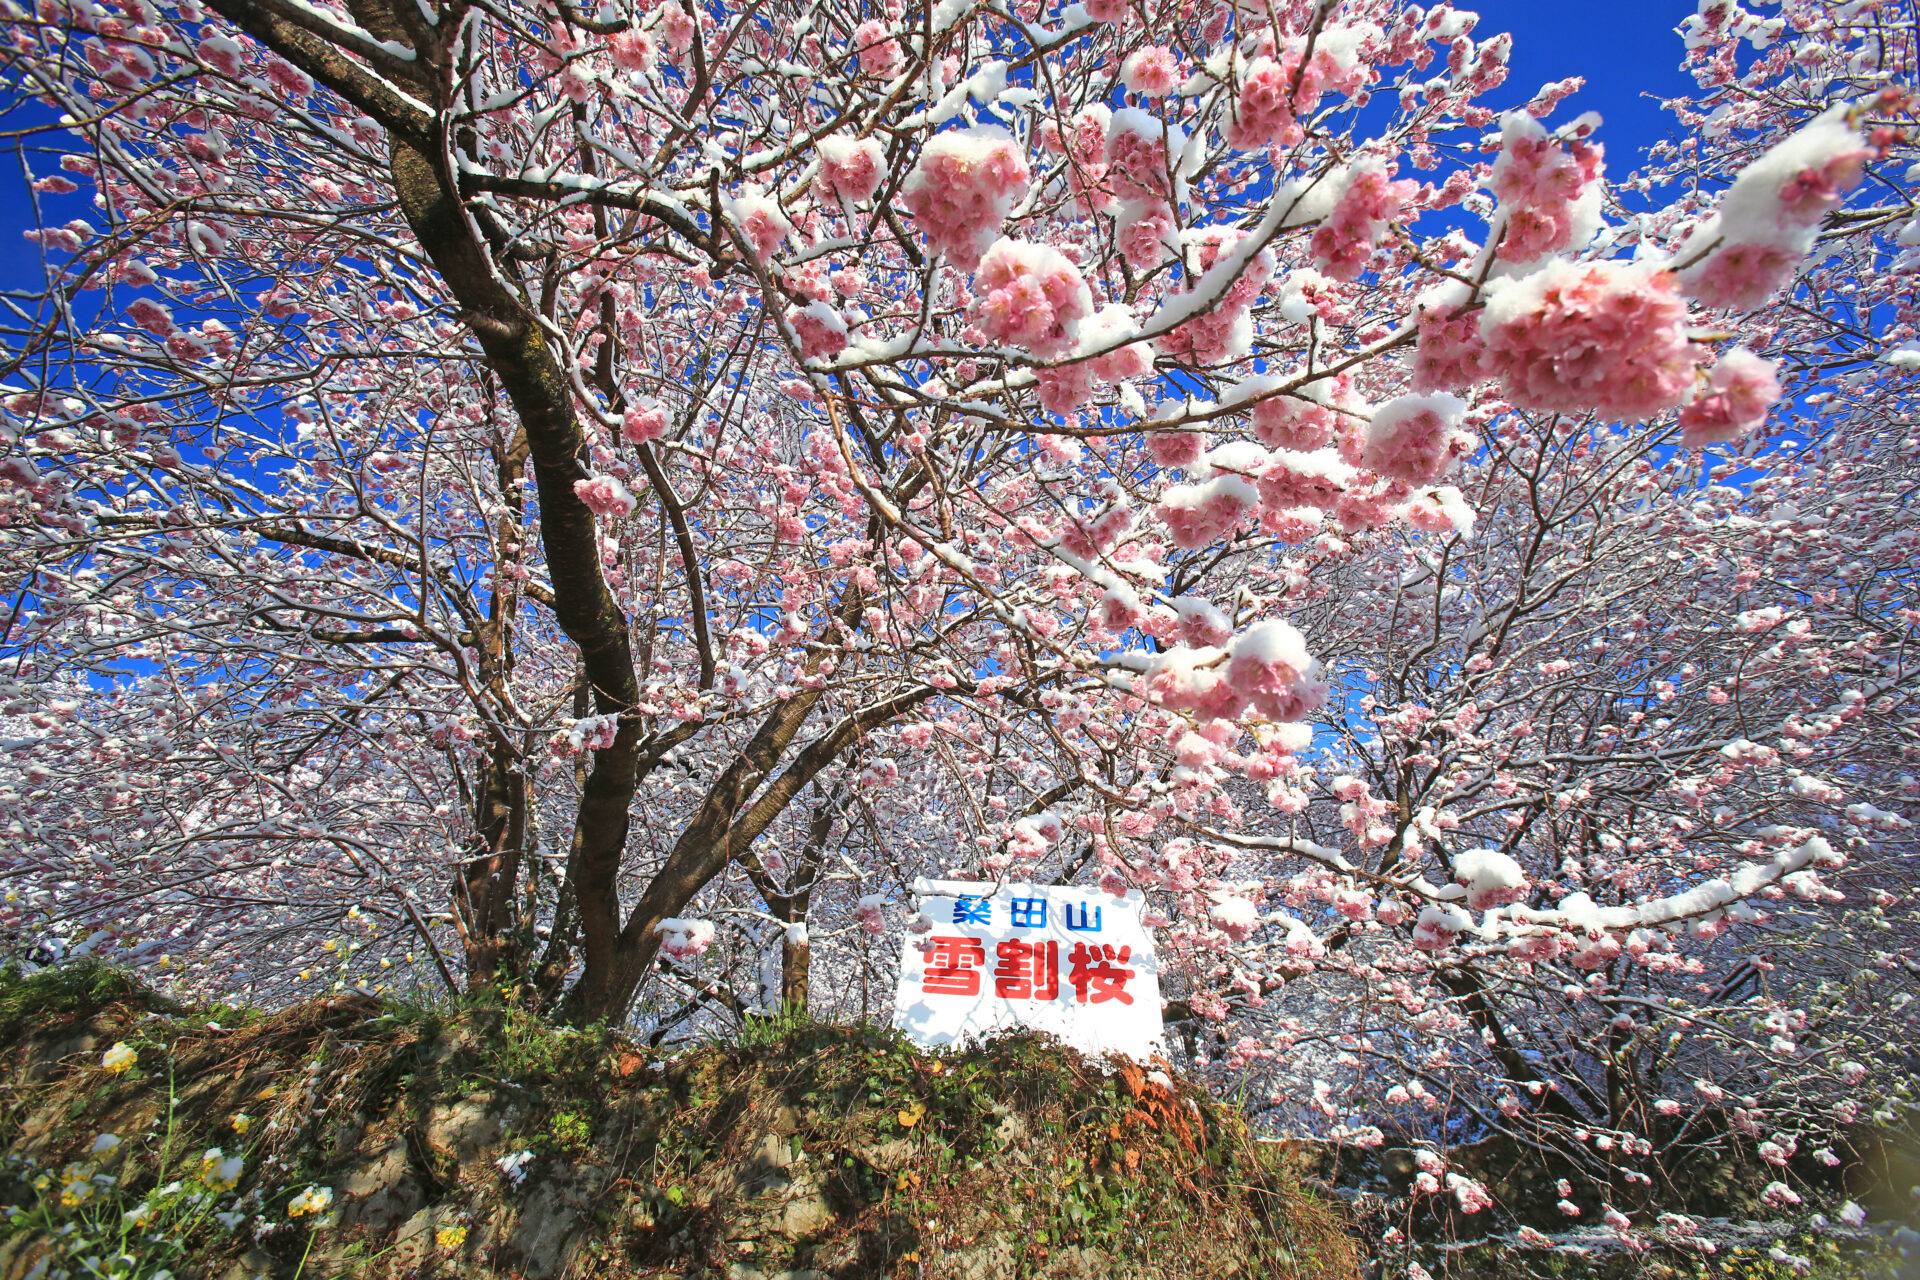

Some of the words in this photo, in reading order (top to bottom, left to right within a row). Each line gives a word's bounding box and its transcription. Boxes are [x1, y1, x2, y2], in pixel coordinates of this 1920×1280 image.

[952, 894, 1102, 931] 桑田山
[922, 935, 1135, 1006] 雪割桜
